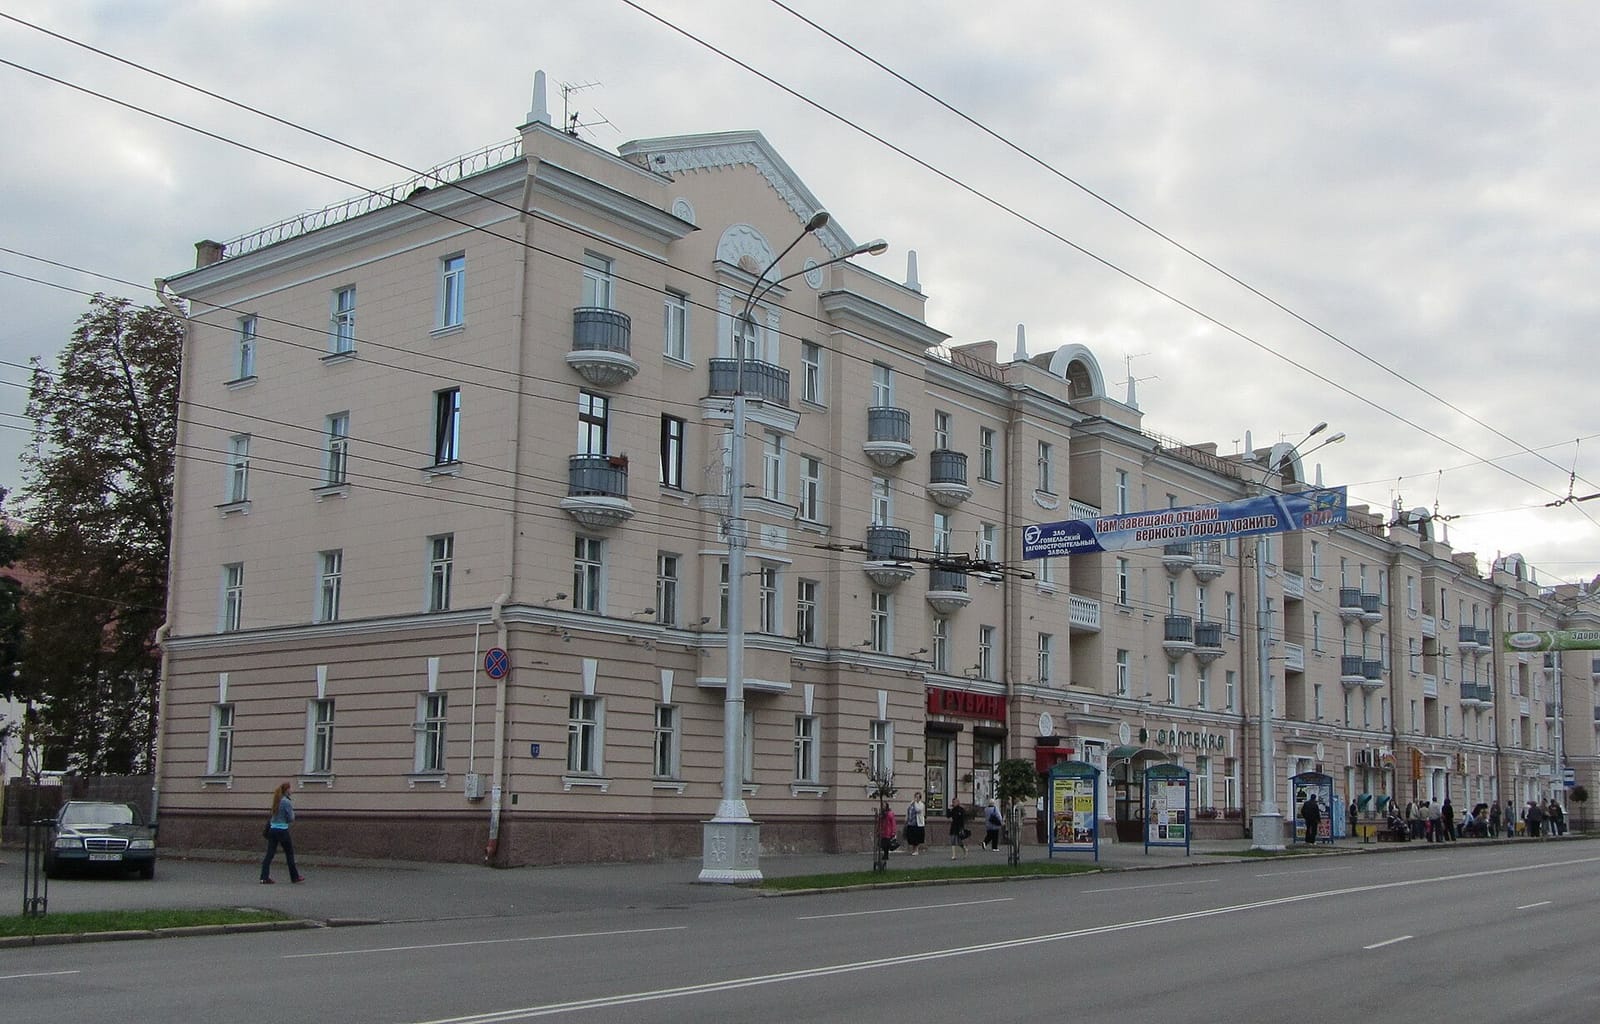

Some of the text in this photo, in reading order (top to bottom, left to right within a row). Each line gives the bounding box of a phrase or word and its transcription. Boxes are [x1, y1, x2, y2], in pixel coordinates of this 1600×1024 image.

[1096, 508, 1218, 533] Нам завещано отцами
[1135, 515, 1277, 541] верность городу хранить
[1052, 529, 1066, 537] ЗАО
[945, 691, 999, 713] РУБИН
[1167, 729, 1215, 750] АПТЕКА
